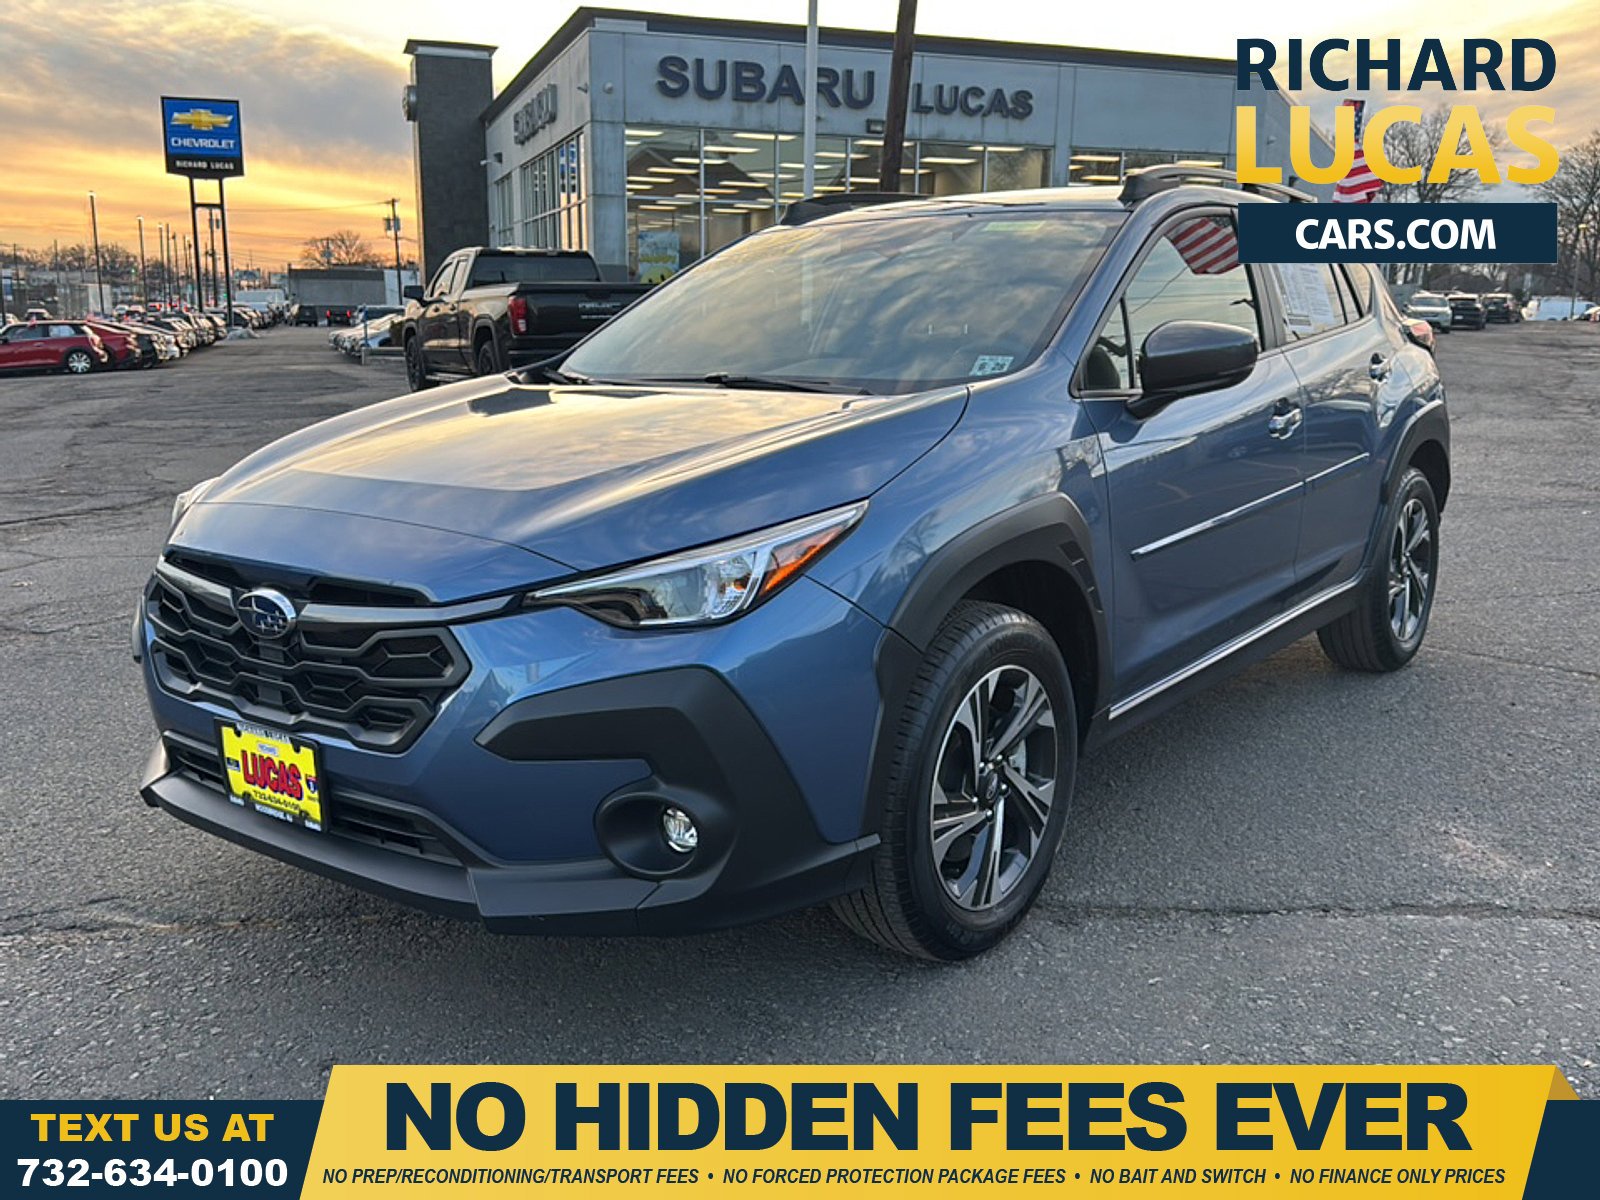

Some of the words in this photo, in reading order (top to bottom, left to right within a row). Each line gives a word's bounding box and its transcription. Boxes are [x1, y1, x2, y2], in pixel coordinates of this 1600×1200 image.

[656, 55, 876, 110] SUBARU
[911, 82, 1034, 120] LUCAS
[170, 136, 235, 150] CHEVROLET
[175, 160, 208, 169] RICHARD
[210, 161, 235, 170] LUCAS
[241, 750, 303, 801] LUCAS
